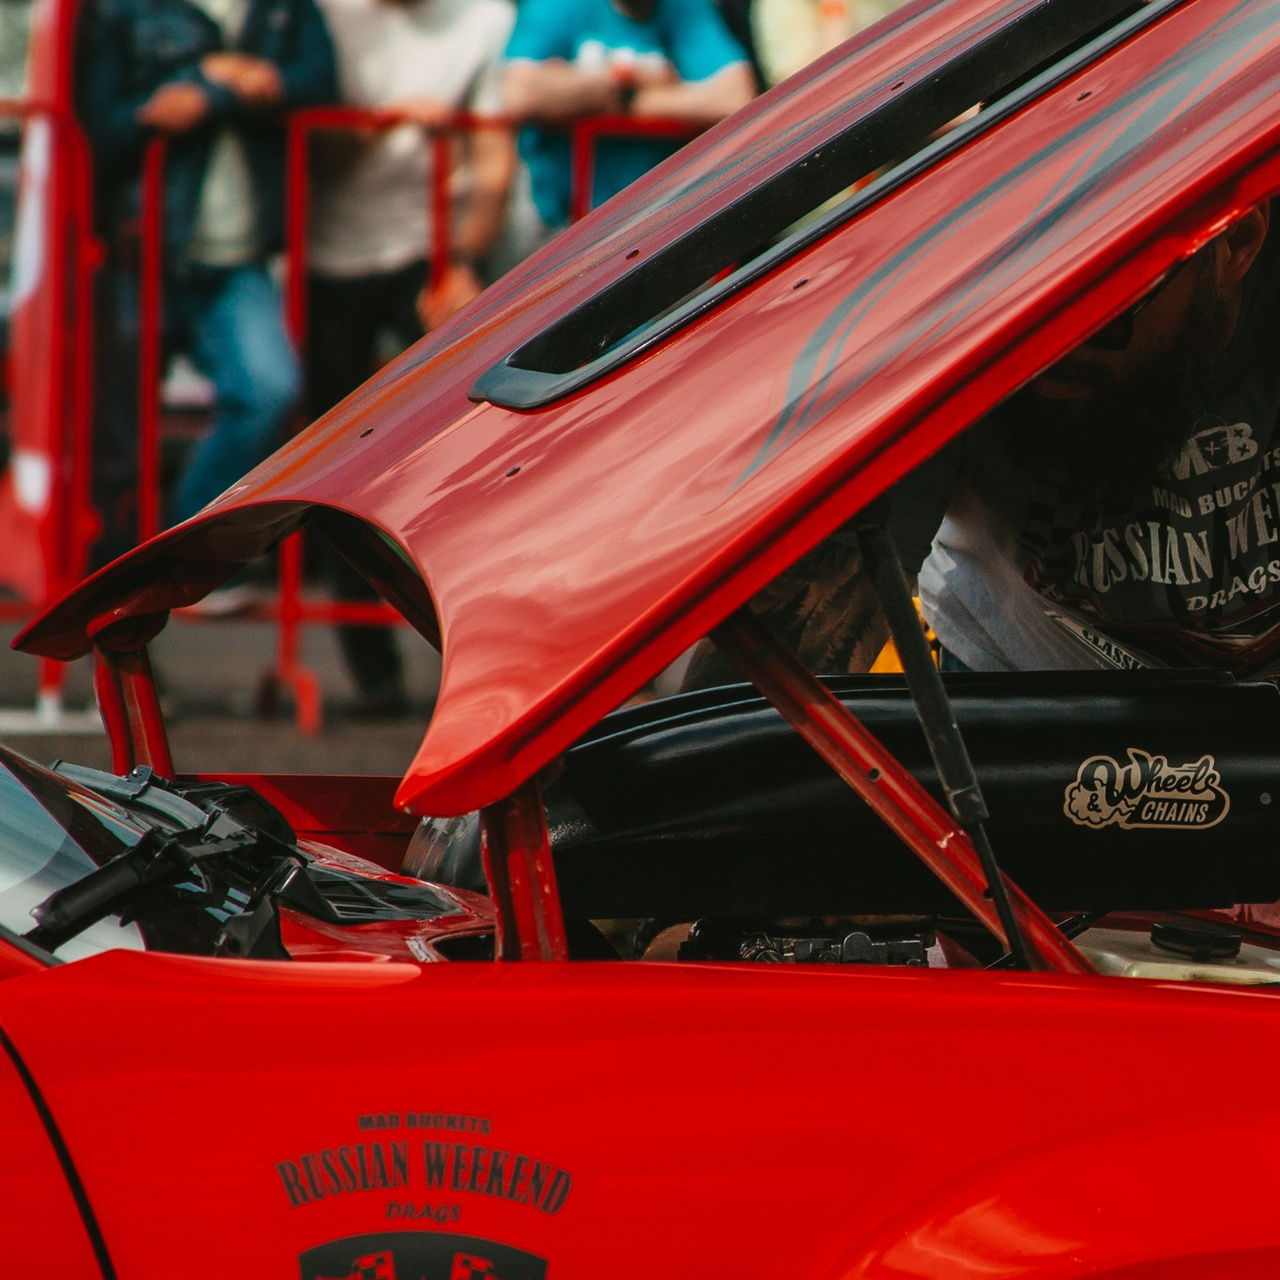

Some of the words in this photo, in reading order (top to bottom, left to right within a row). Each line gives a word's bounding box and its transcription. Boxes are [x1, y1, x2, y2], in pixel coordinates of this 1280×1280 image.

[1152, 486, 1192, 518] MAD
[1071, 521, 1214, 593] RUSSIAN
[1080, 752, 1218, 807] Wheels
[1089, 792, 1102, 812] &
[1141, 801, 1209, 823] CHAINS
[358, 1112, 401, 1132] MAD
[276, 1142, 409, 1209] RUSSIAN
[422, 1140, 573, 1214] WEEKEND
[386, 1201, 461, 1224] DRAGS
